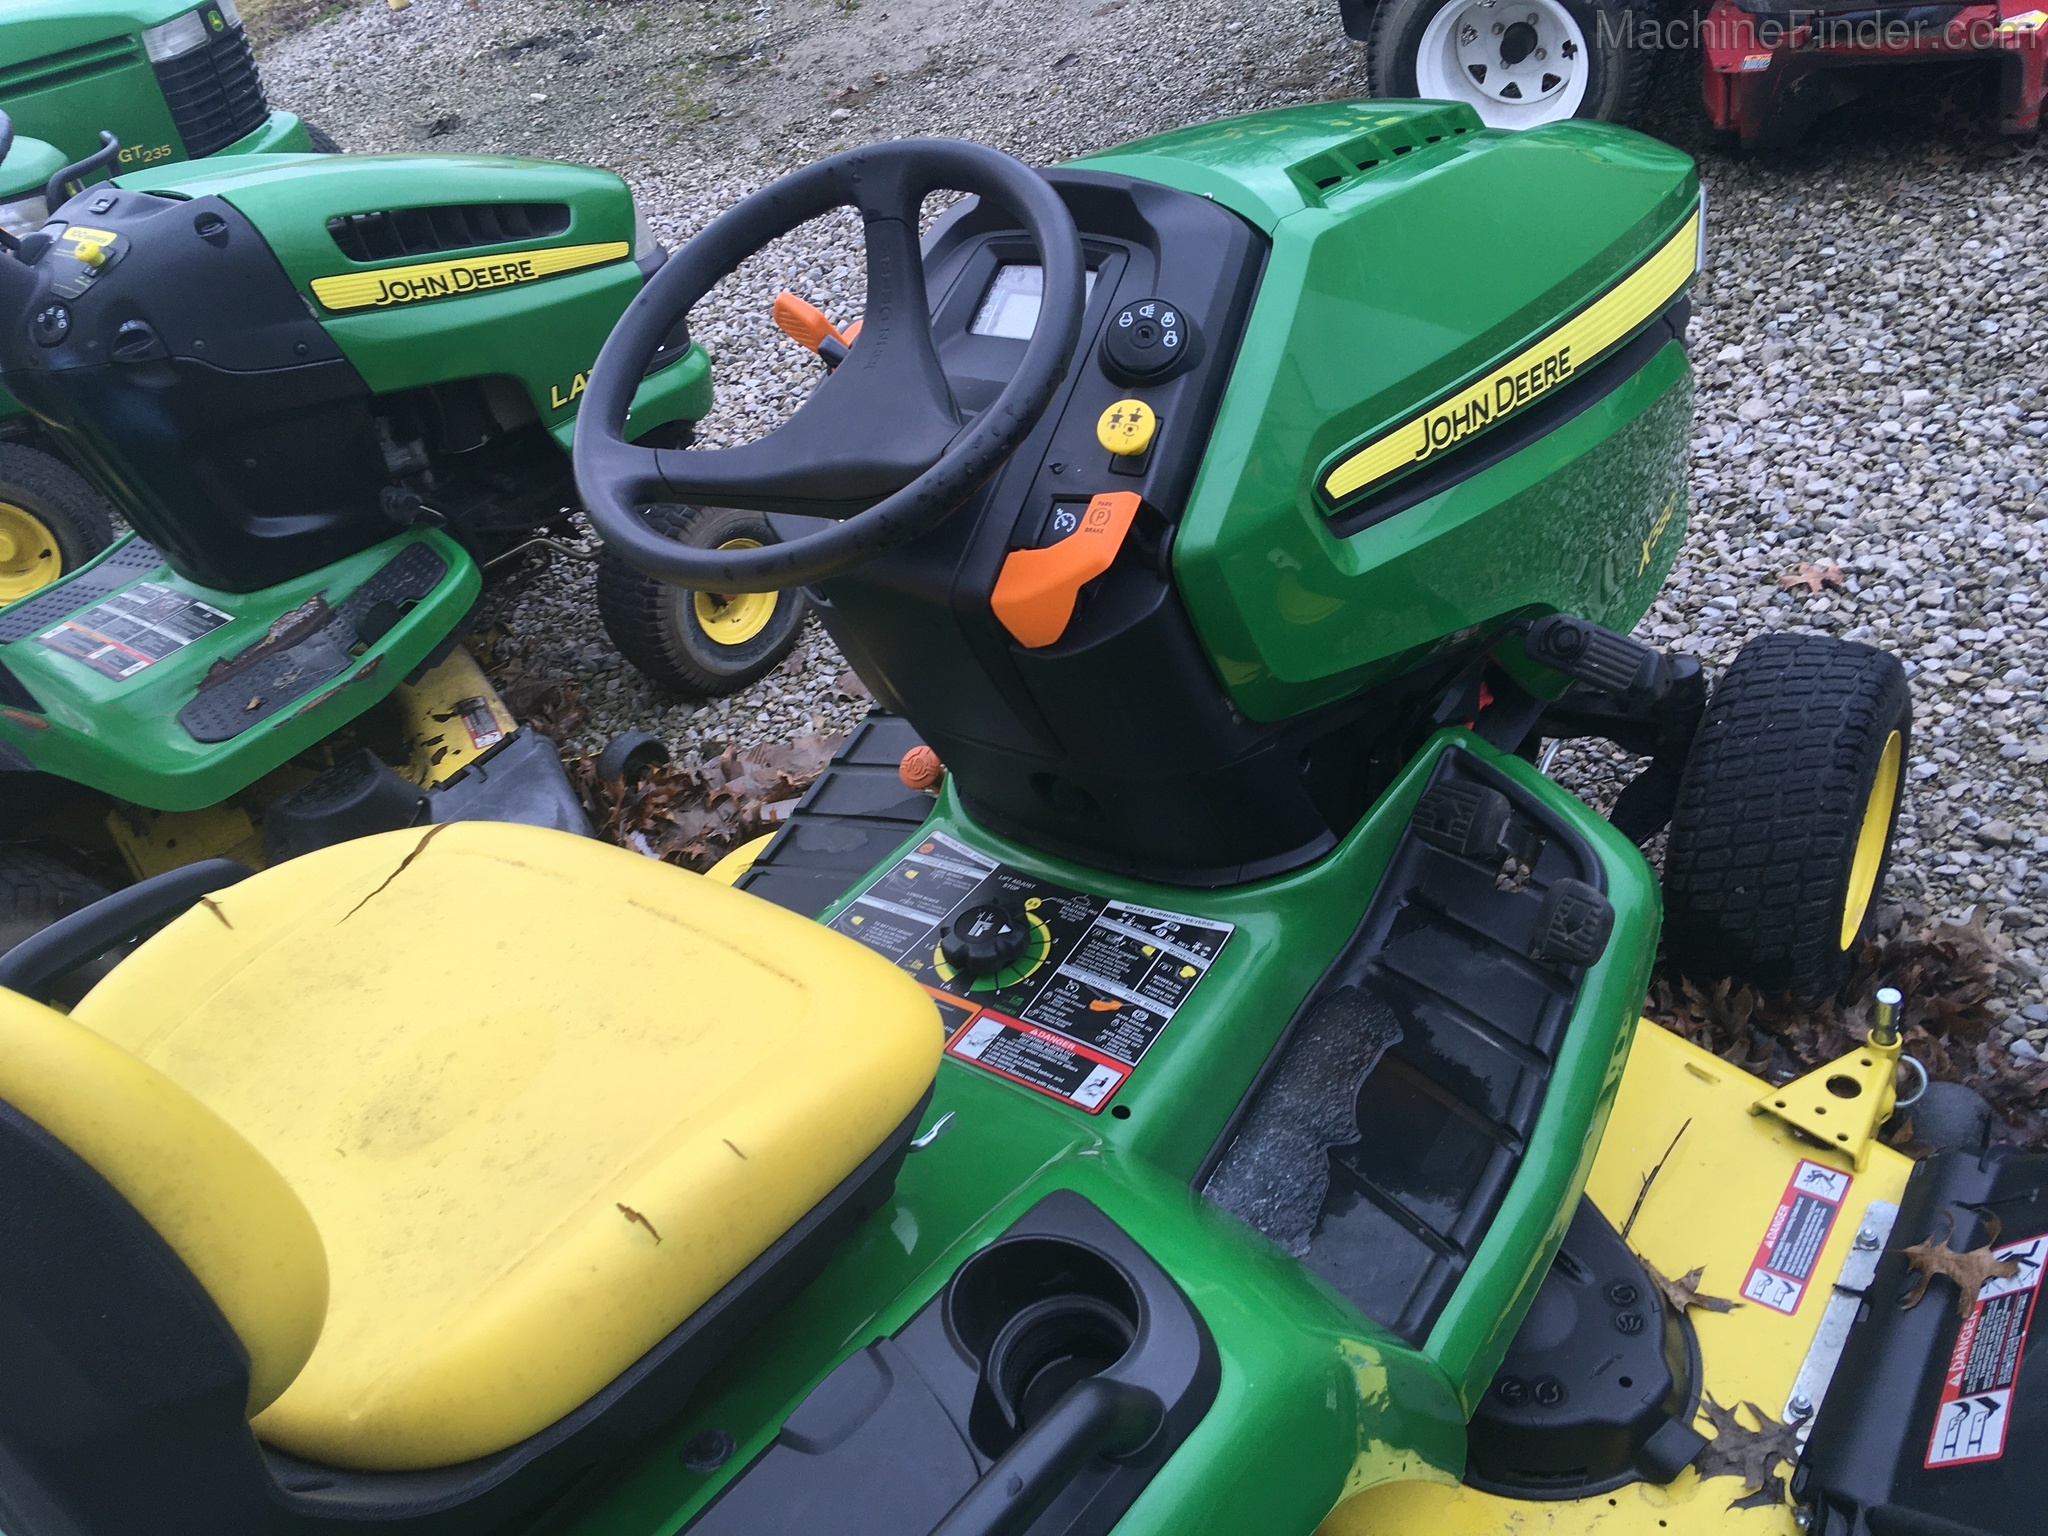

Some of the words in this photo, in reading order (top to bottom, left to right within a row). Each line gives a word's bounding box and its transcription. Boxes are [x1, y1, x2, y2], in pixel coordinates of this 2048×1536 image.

[118, 144, 172, 163] GT235
[375, 275, 449, 303] JOHN
[450, 260, 536, 290] DEERE
[1415, 393, 1489, 458] JOHN
[1495, 345, 1572, 417] DEERE
[1011, 878, 1035, 888] ADJUST
[1059, 967, 1082, 977] CRUISE
[1083, 976, 1114, 990] CONTROL
[1151, 974, 1173, 985] MOWER
[1144, 984, 1164, 995] MOWER
[1040, 1031, 1076, 1050] DANGER
[1768, 1204, 1790, 1241] DANGER
